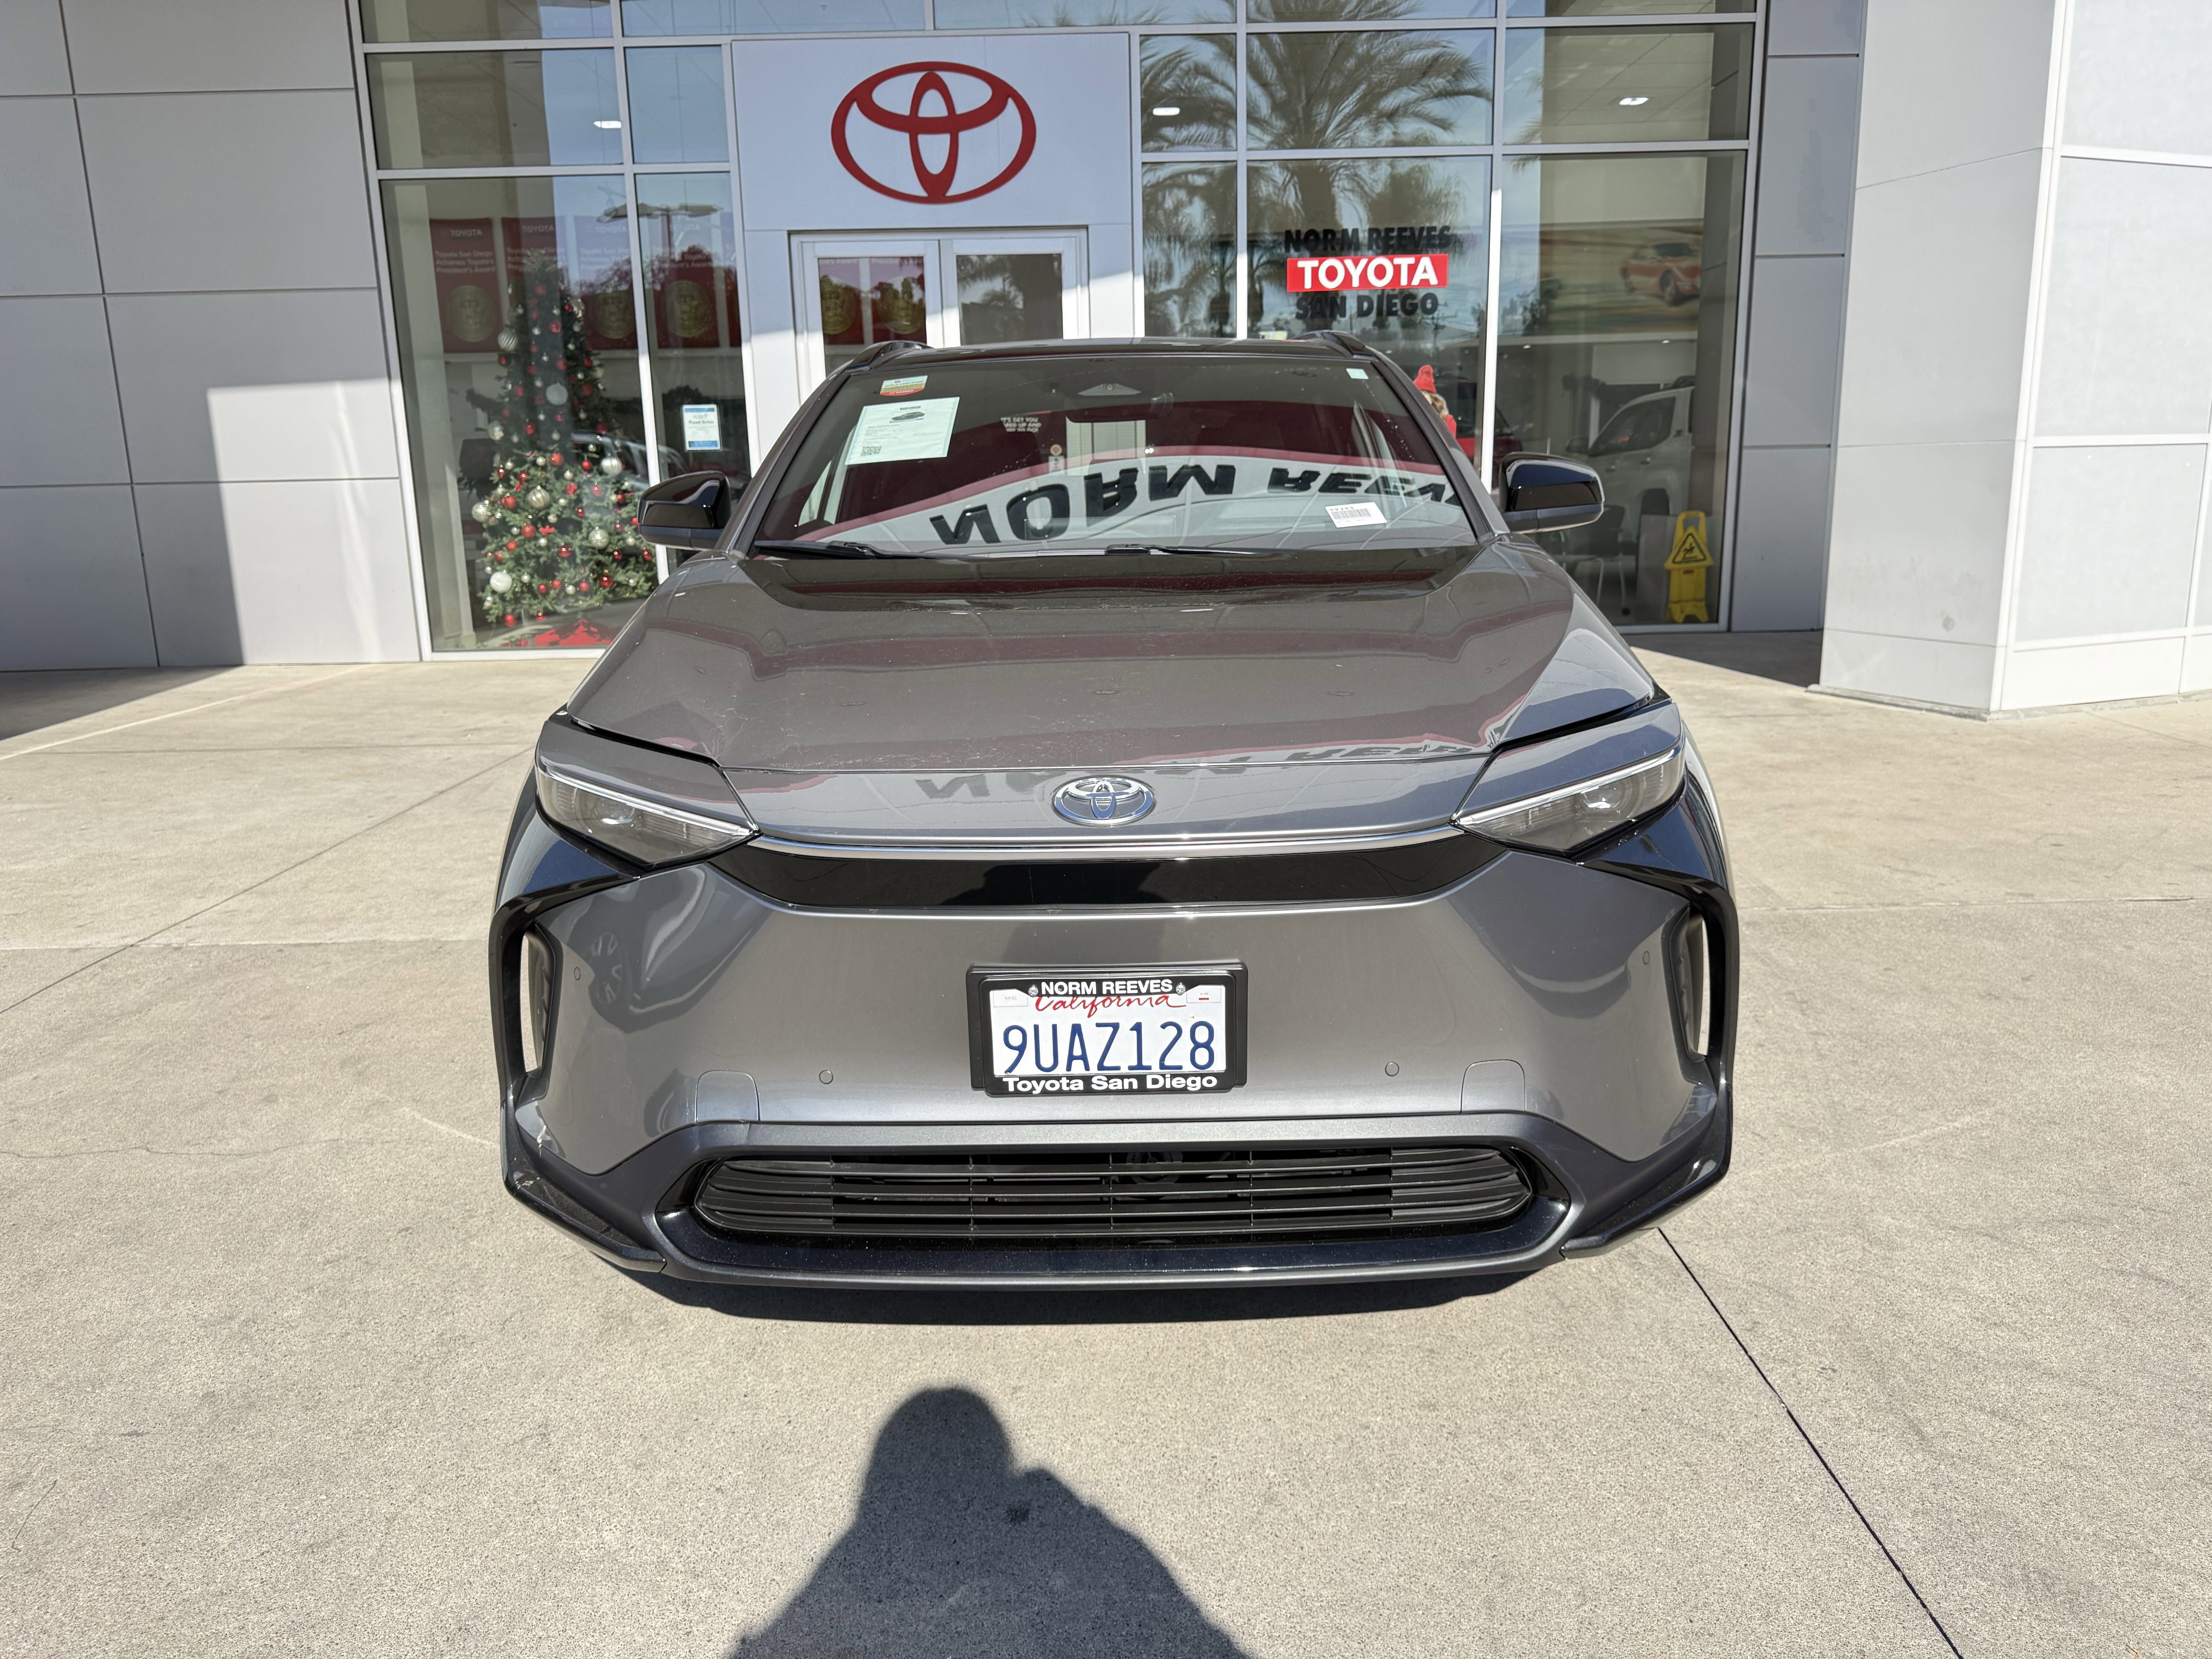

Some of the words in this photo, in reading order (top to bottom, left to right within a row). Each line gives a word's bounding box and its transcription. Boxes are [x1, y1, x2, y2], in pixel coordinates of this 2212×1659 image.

[450, 229, 483, 237] TOYOTA
[1284, 228, 1360, 253] NORM
[1368, 226, 1451, 251] REEVES
[1297, 257, 1438, 289] TOYOTA
[1295, 295, 1346, 320] SAN
[1357, 293, 1439, 318] DIEGO
[1041, 981, 1096, 995] NORM
[1103, 979, 1173, 994] REEVES
[1036, 994, 1187, 1018] California
[1003, 1021, 1214, 1074] 9UAZ128
[1003, 1077, 1084, 1094] Toyota
[1091, 1075, 1138, 1090] San
[1146, 1074, 1217, 1091] Diego
